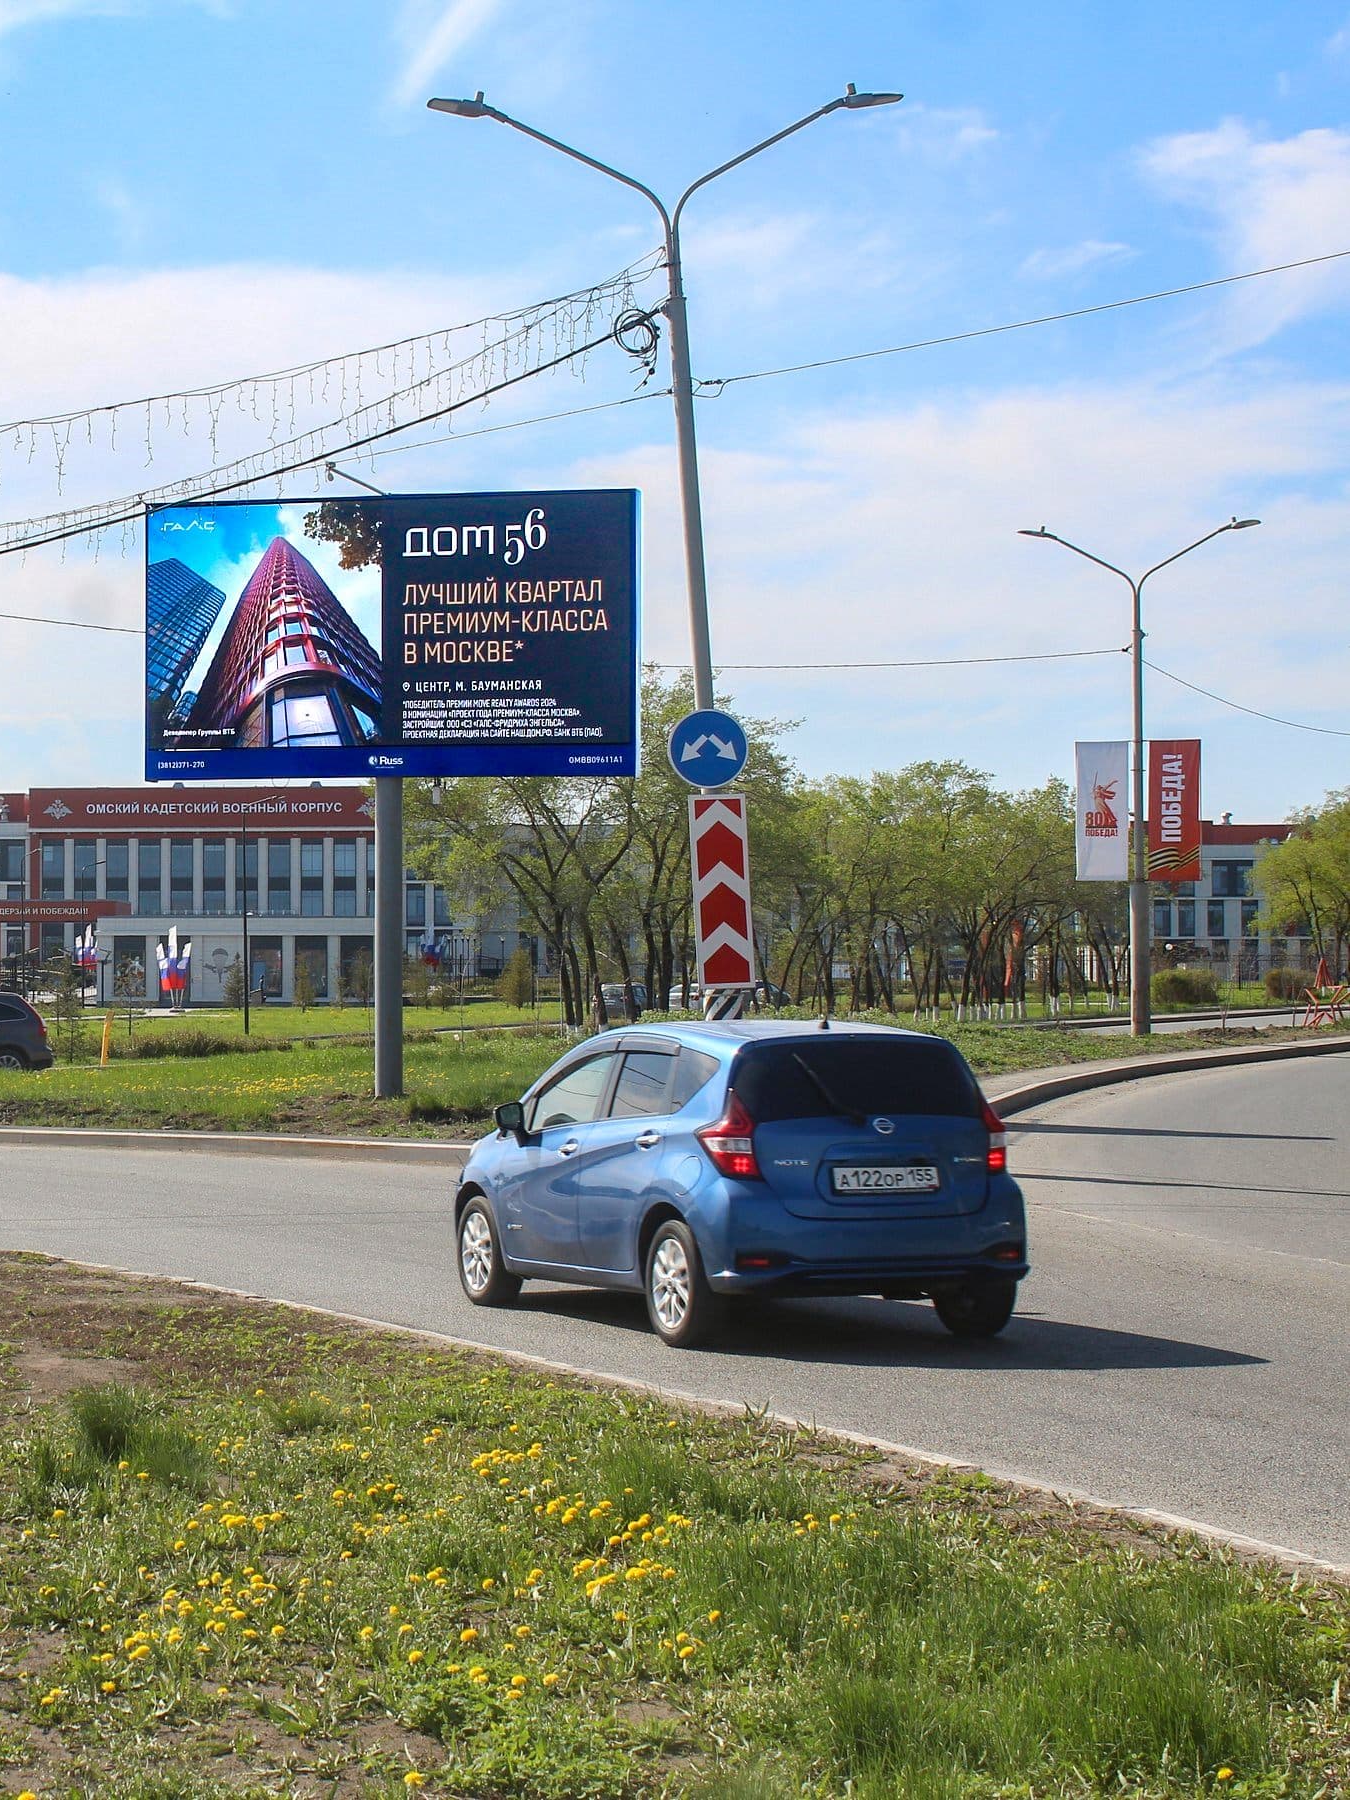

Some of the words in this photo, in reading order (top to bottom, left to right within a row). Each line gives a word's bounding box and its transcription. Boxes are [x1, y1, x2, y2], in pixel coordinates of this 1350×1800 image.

[503, 508, 547, 565] 56
[403, 577, 497, 605] ЛУЧШИЙ
[505, 580, 602, 604] КВАРТАЛ
[404, 609, 608, 635] ПРЕМИУМ-КЛАССА
[404, 642, 417, 664] В
[415, 681, 452, 693] ЦЕНТР,
[455, 681, 467, 691] М.
[471, 680, 542, 691] БАУМАНСКАЯ
[493, 708, 549, 718] ПРЕМИУМ-КЛАССА
[402, 730, 437, 739] ПРОЕКТНАЯ
[481, 729, 489, 737] НА
[571, 727, 583, 737] ВТБ
[379, 755, 404, 765] Russ
[1161, 754, 1185, 842] ПОБЕДА!
[86, 801, 139, 814] ОМСКИЙ
[144, 801, 219, 814] КАДЕТСКИЙ
[223, 800, 287, 813] ВОЕННЫЙ
[291, 802, 342, 813] КОРПУС
[1085, 811, 1104, 827] 80
[1085, 828, 1118, 838] ПОБЕДА!
[0, 906, 30, 915] ДЕРЗАЙ
[40, 906, 88, 915] ПОБЕЖДАЙ!
